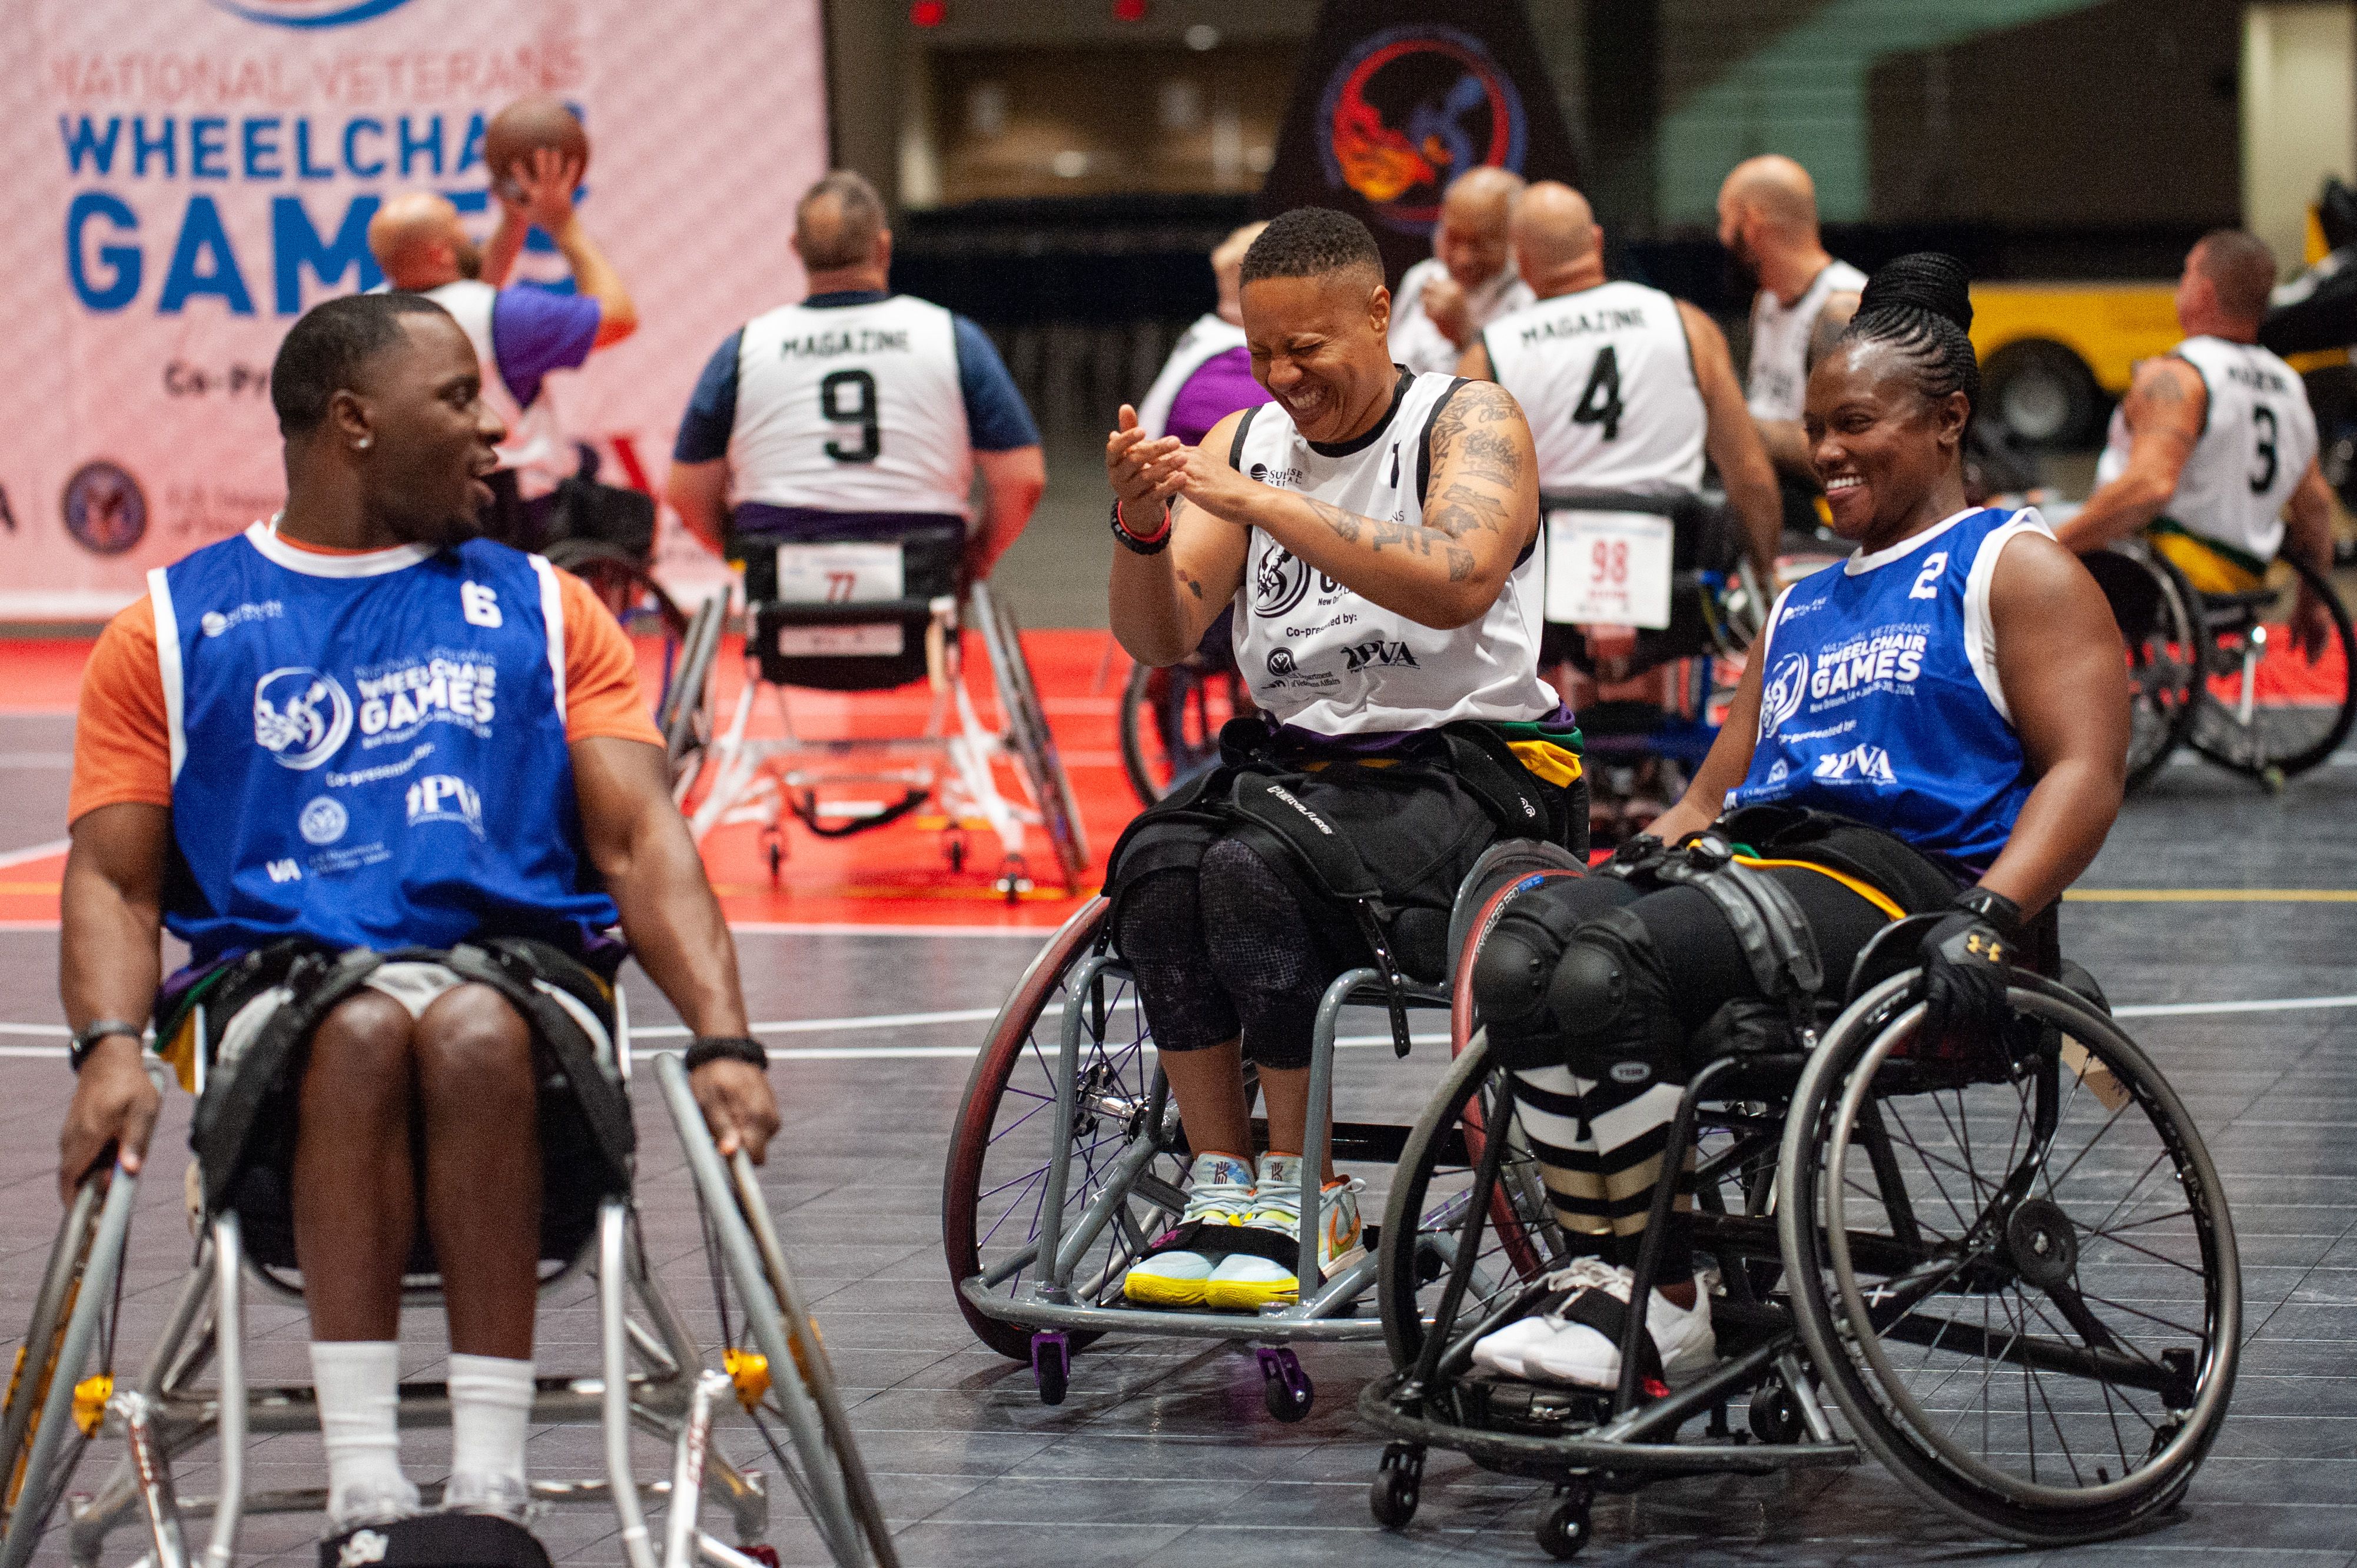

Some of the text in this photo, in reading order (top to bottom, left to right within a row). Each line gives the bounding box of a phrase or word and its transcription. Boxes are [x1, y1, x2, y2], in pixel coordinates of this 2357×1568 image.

[59, 102, 585, 179] WHEELCHA
[66, 186, 589, 315] GAM
[781, 328, 911, 360] MAGAZINE
[1519, 308, 1647, 347] MAGAZINE
[821, 369, 879, 464] 9
[1572, 344, 1624, 444] 4
[2248, 402, 2279, 497] 3
[1591, 539, 1629, 584] 98
[1908, 552, 1948, 599] 2
[461, 580, 503, 628] 6
[825, 571, 856, 602] 77
[1343, 613, 1357, 624] by:
[1811, 648, 1924, 700] GAMES
[1817, 633, 1927, 669] WHEELCHAIR
[359, 677, 496, 735] GAMES
[1828, 743, 1896, 779] PVA
